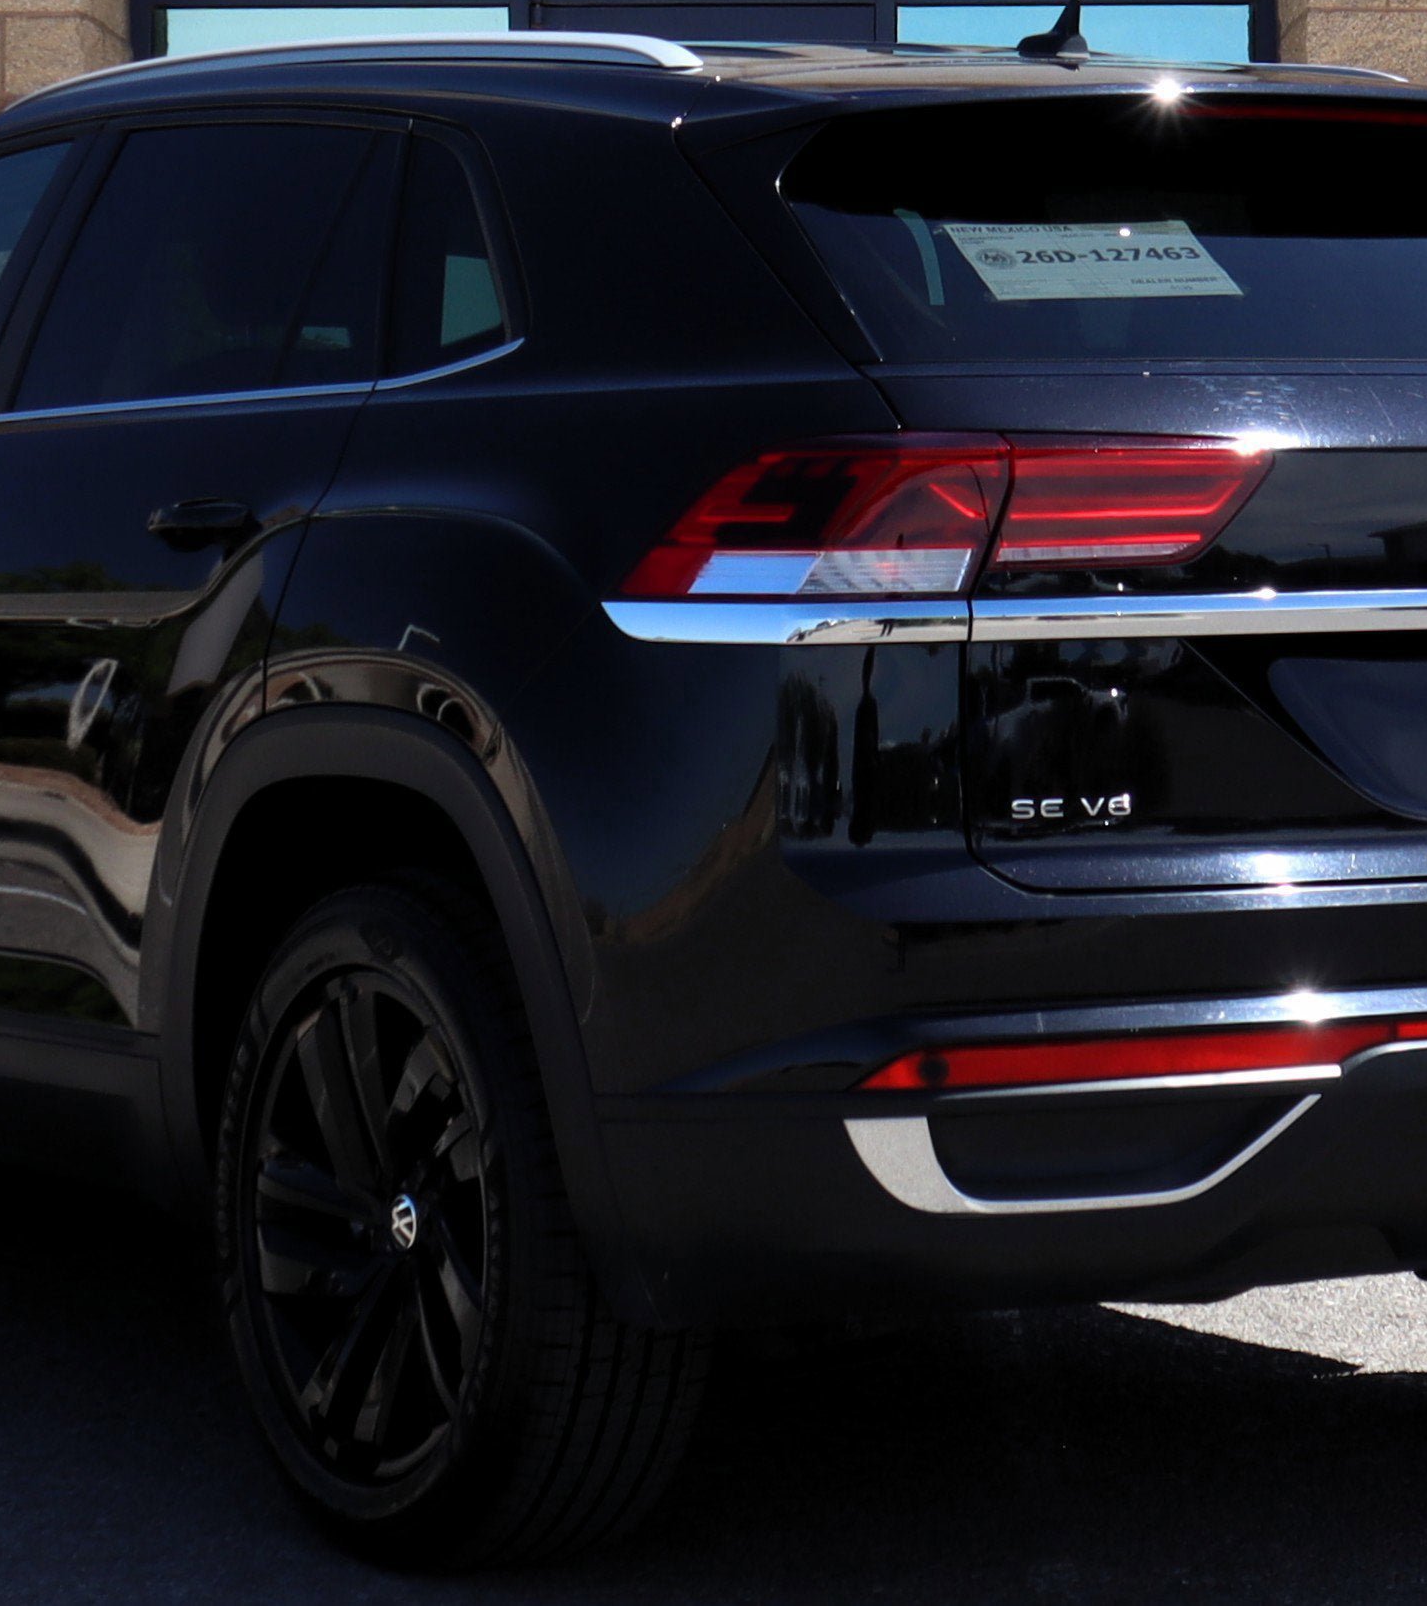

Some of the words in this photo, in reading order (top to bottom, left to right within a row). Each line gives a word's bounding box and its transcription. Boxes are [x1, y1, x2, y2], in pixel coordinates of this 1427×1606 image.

[1016, 247, 1201, 264] 26D-127463
[1011, 798, 1064, 819] SE
[1080, 794, 1131, 816] V6
